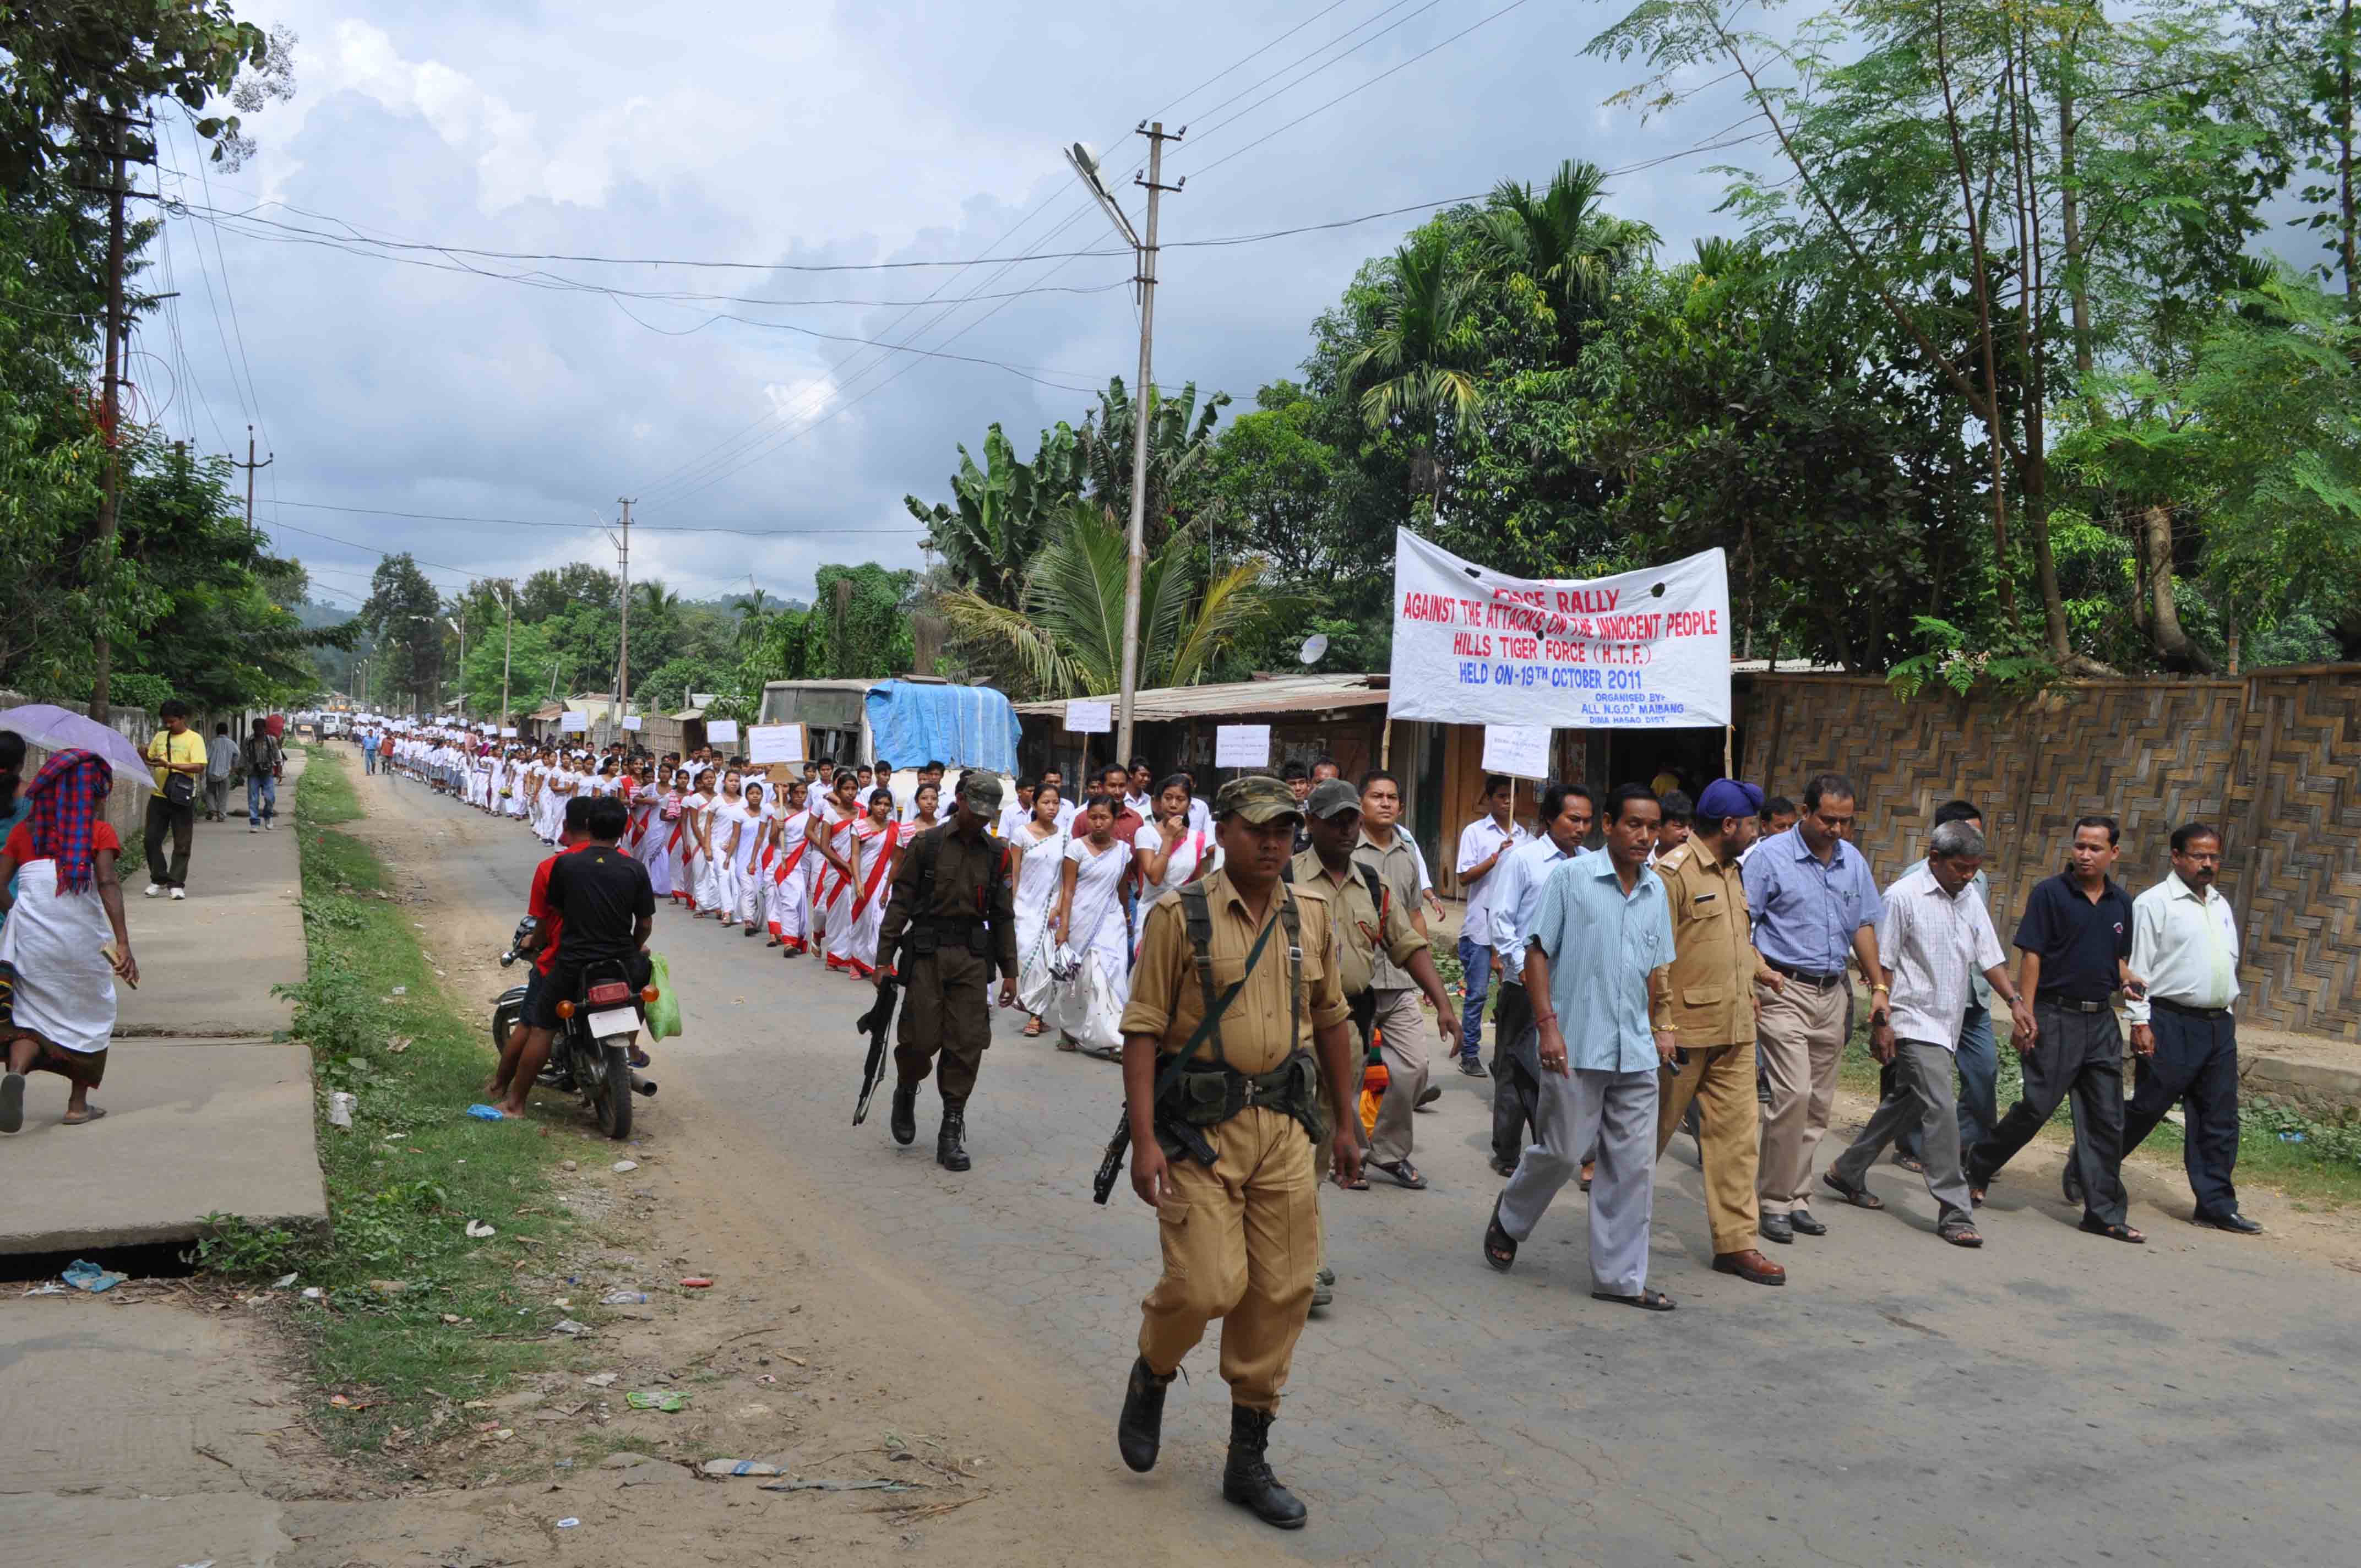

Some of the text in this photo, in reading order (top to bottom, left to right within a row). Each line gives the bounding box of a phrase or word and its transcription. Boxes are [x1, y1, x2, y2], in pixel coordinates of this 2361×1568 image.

[1557, 590, 1620, 613] RALLY
[1403, 592, 1717, 640] AGAINST THE ATTACKS ON THE INNOCENT PEOPLE
[1454, 633, 1651, 665] HILLS TIGER FORCE (H.T.F.)
[1459, 662, 1488, 684] HELD
[1552, 668, 1602, 689] OCTOBER
[1608, 669, 1642, 689] 2011
[1581, 704, 1600, 714] ALL
[1639, 704, 1684, 714] MAIBANG
[1595, 693, 1646, 702] ORGANISED
